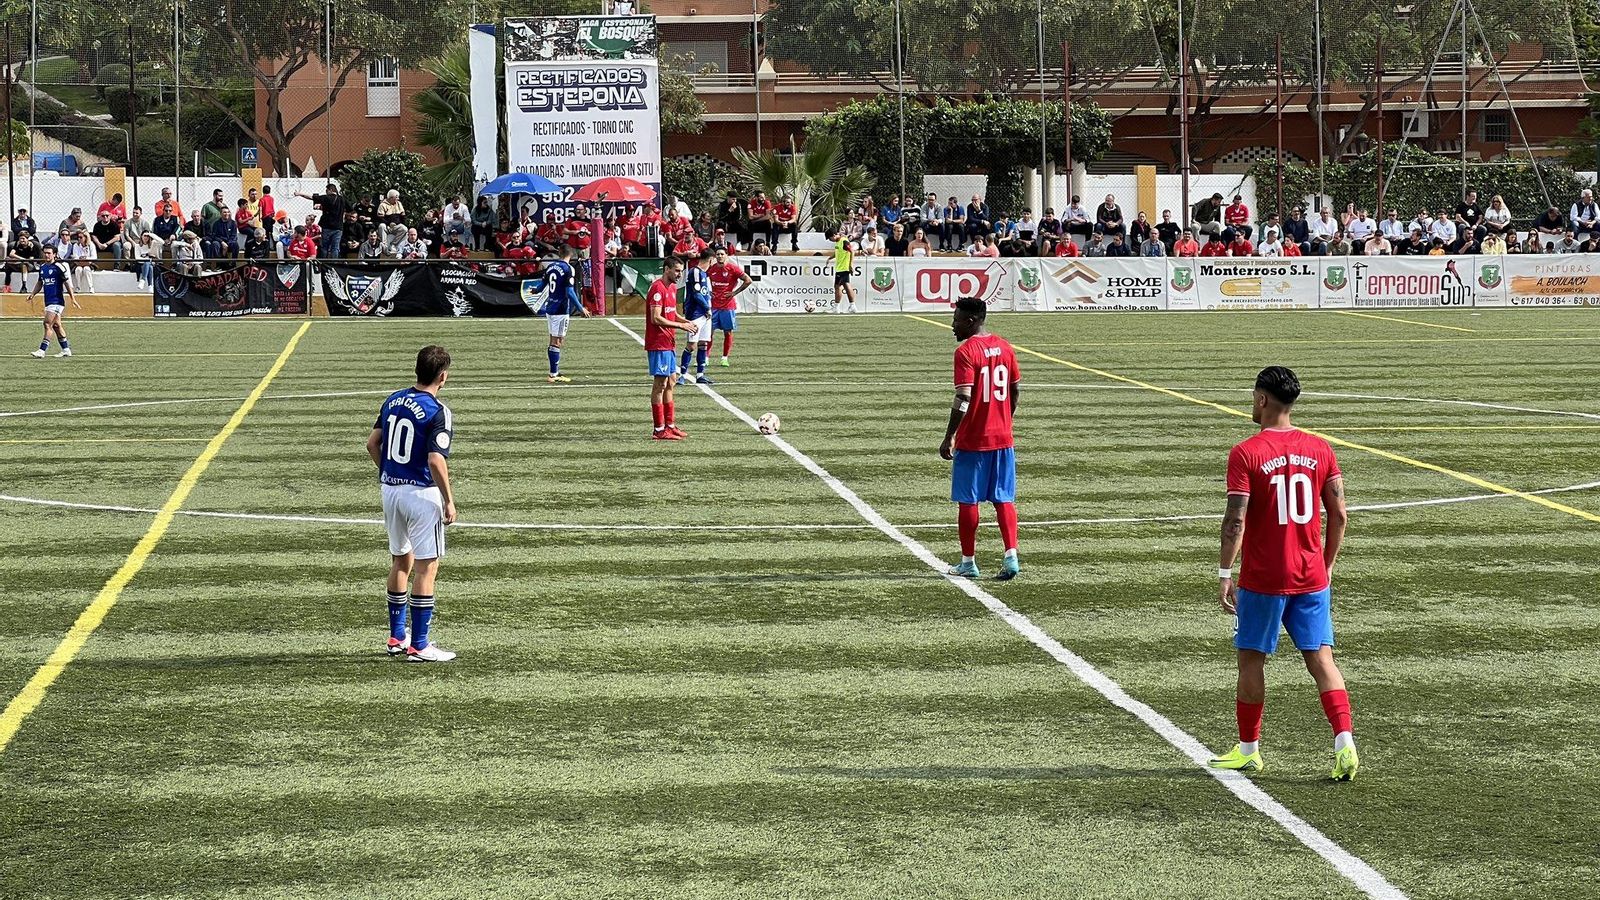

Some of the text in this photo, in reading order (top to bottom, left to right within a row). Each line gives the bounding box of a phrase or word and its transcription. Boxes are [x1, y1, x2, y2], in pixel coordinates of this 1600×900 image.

[516, 69, 646, 87] RECTIFICADOS
[517, 88, 647, 112] ESTEPONA
[533, 122, 586, 136] RECTIFICADOS
[592, 121, 616, 134] TORNO
[618, 120, 634, 134] CNC
[531, 143, 575, 157] FRESADORA
[582, 142, 637, 155] ULTRASONIDOS
[515, 164, 565, 178] SOLDADURAS
[571, 163, 626, 177] MANDRINADOS
[627, 163, 635, 176] IN
[637, 162, 654, 176] SITU
[243, 266, 268, 282] RED
[441, 269, 477, 278] ASOCIACIÓN
[1200, 264, 1316, 276] Monterroso S.L.
[1536, 265, 1591, 273] PINTURAS
[440, 277, 464, 285] ARMADA
[549, 272, 556, 293] 6
[920, 272, 981, 306] up
[1107, 278, 1162, 287] HOME
[1536, 277, 1588, 287] A. BOULAICH
[1116, 288, 1162, 298] HELP
[767, 299, 783, 308] Tel.
[786, 299, 801, 308] 951
[816, 299, 828, 308] 62
[980, 364, 1008, 402] 19
[404, 398, 426, 420] CANO
[387, 414, 414, 464] 10
[1261, 456, 1287, 474] HUGO
[1270, 473, 1313, 525] 10
